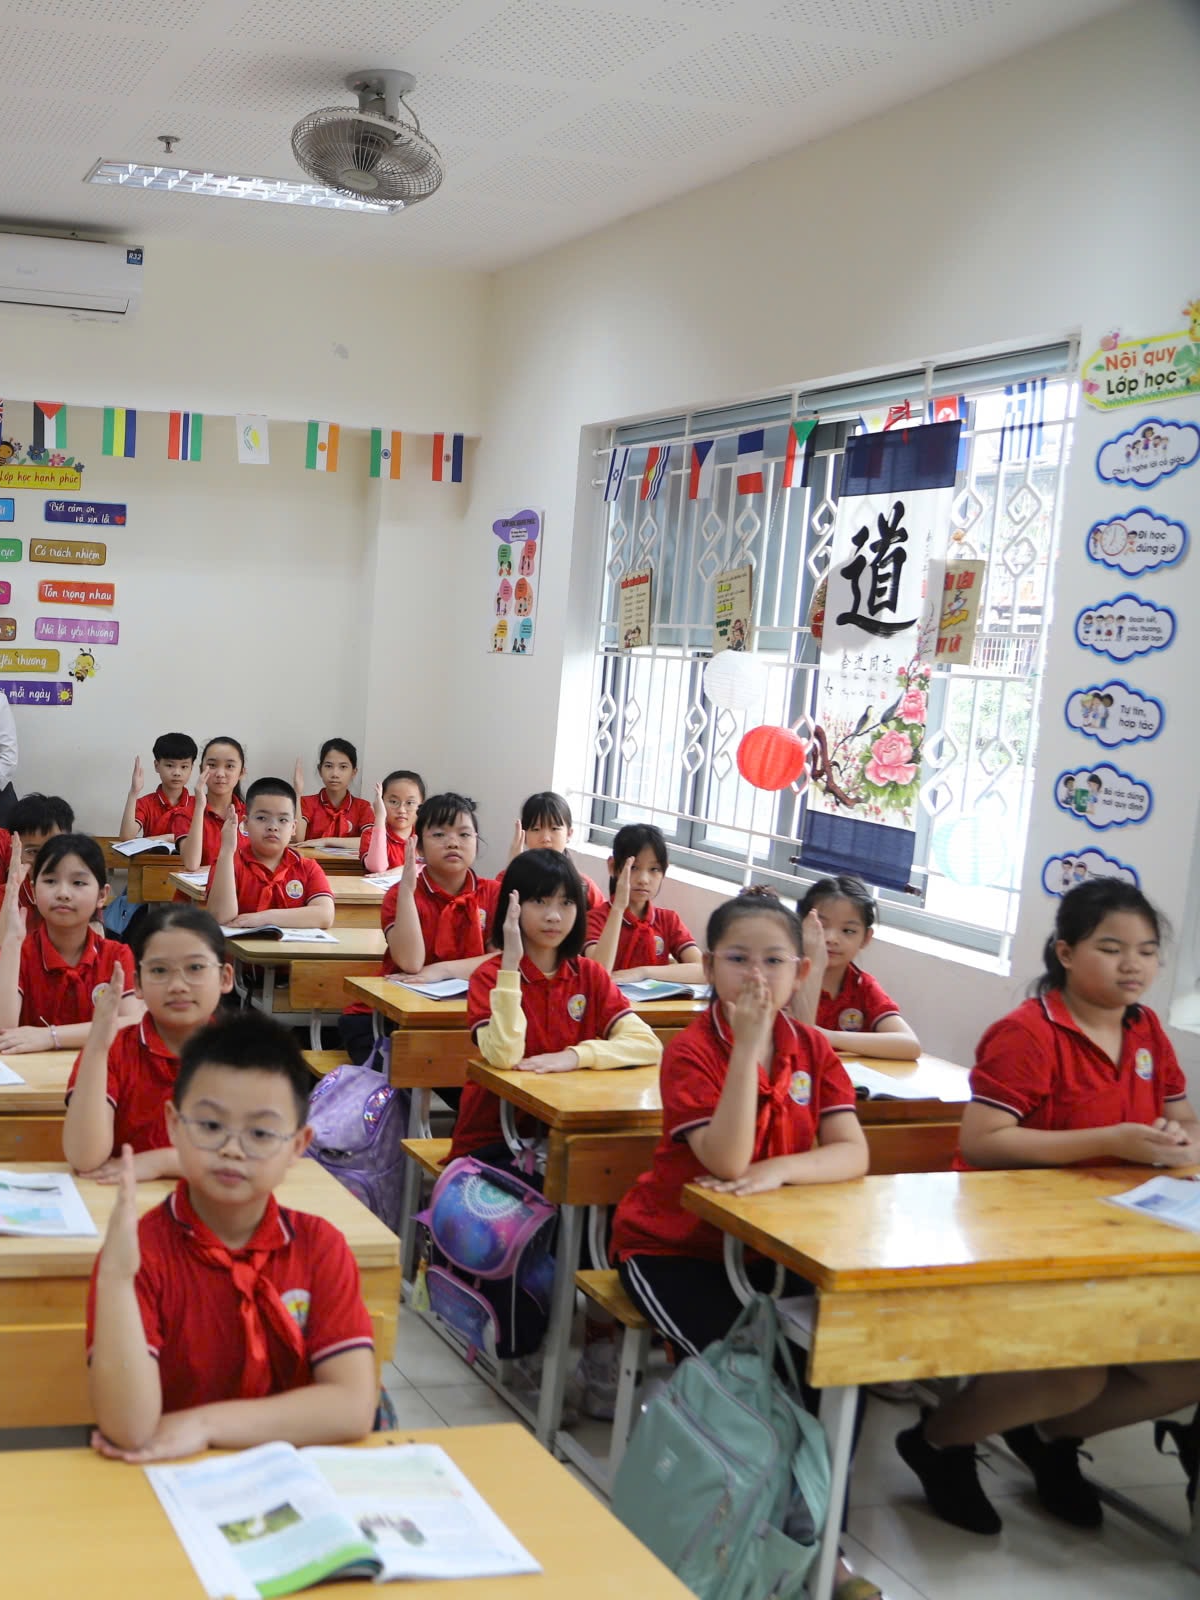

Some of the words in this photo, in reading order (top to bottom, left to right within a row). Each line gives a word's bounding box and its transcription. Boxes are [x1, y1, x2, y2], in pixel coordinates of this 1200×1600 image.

[1104, 351, 1137, 373] Nội
[1143, 346, 1177, 366] quy
[1106, 375, 1139, 395] Lớp
[1144, 371, 1177, 390] học
[0, 471, 14, 484] Lớp
[17, 471, 31, 483] học
[35, 472, 55, 484] hạnh
[59, 473, 79, 486] phúc
[1150, 529, 1168, 542] học
[34, 544, 46, 556] Có
[50, 546, 72, 558] trách
[75, 548, 101, 562] nhiệm
[836, 500, 919, 639] 道
[62, 589, 86, 602] trọng
[89, 588, 112, 600] nhau
[28, 688, 51, 702] ngày
